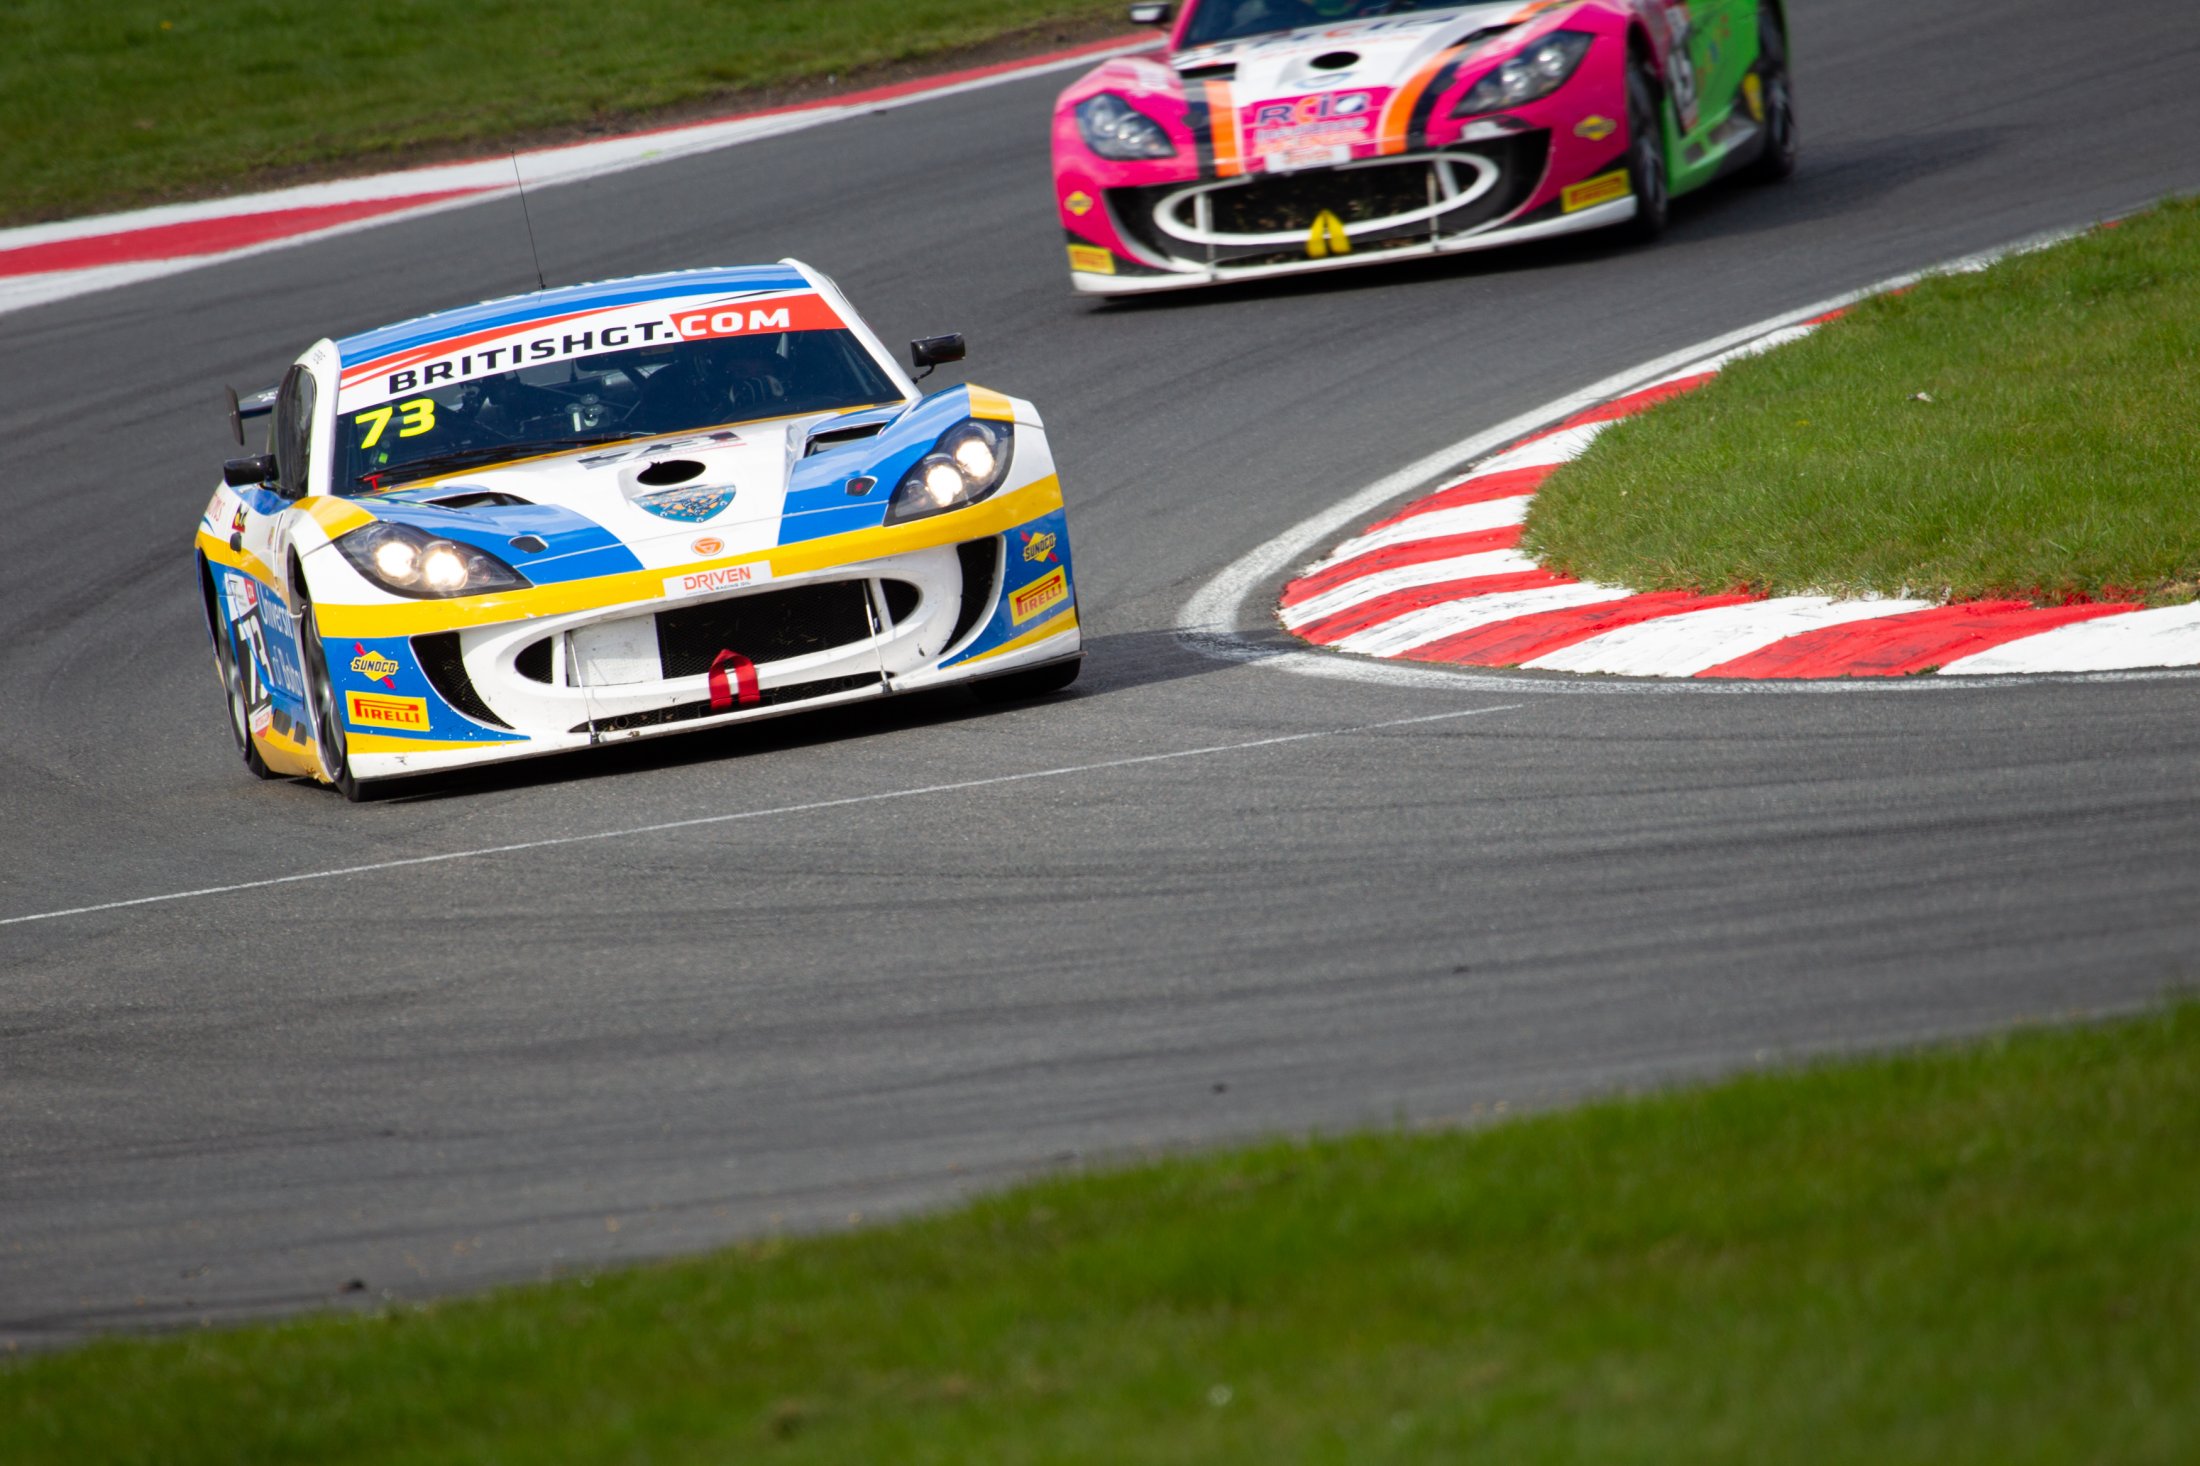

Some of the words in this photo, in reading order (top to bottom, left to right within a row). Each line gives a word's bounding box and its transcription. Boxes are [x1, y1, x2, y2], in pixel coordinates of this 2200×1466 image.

[389, 308, 790, 394] BRITISHGT.COM
[355, 398, 436, 449] 73
[1024, 534, 1055, 559] SUNOCO
[683, 566, 751, 591] DRIVEN
[1015, 575, 1062, 616] PIRELLI
[238, 615, 275, 704] 73
[353, 658, 397, 674] SUNOCO
[354, 699, 419, 723] PIRELLI
